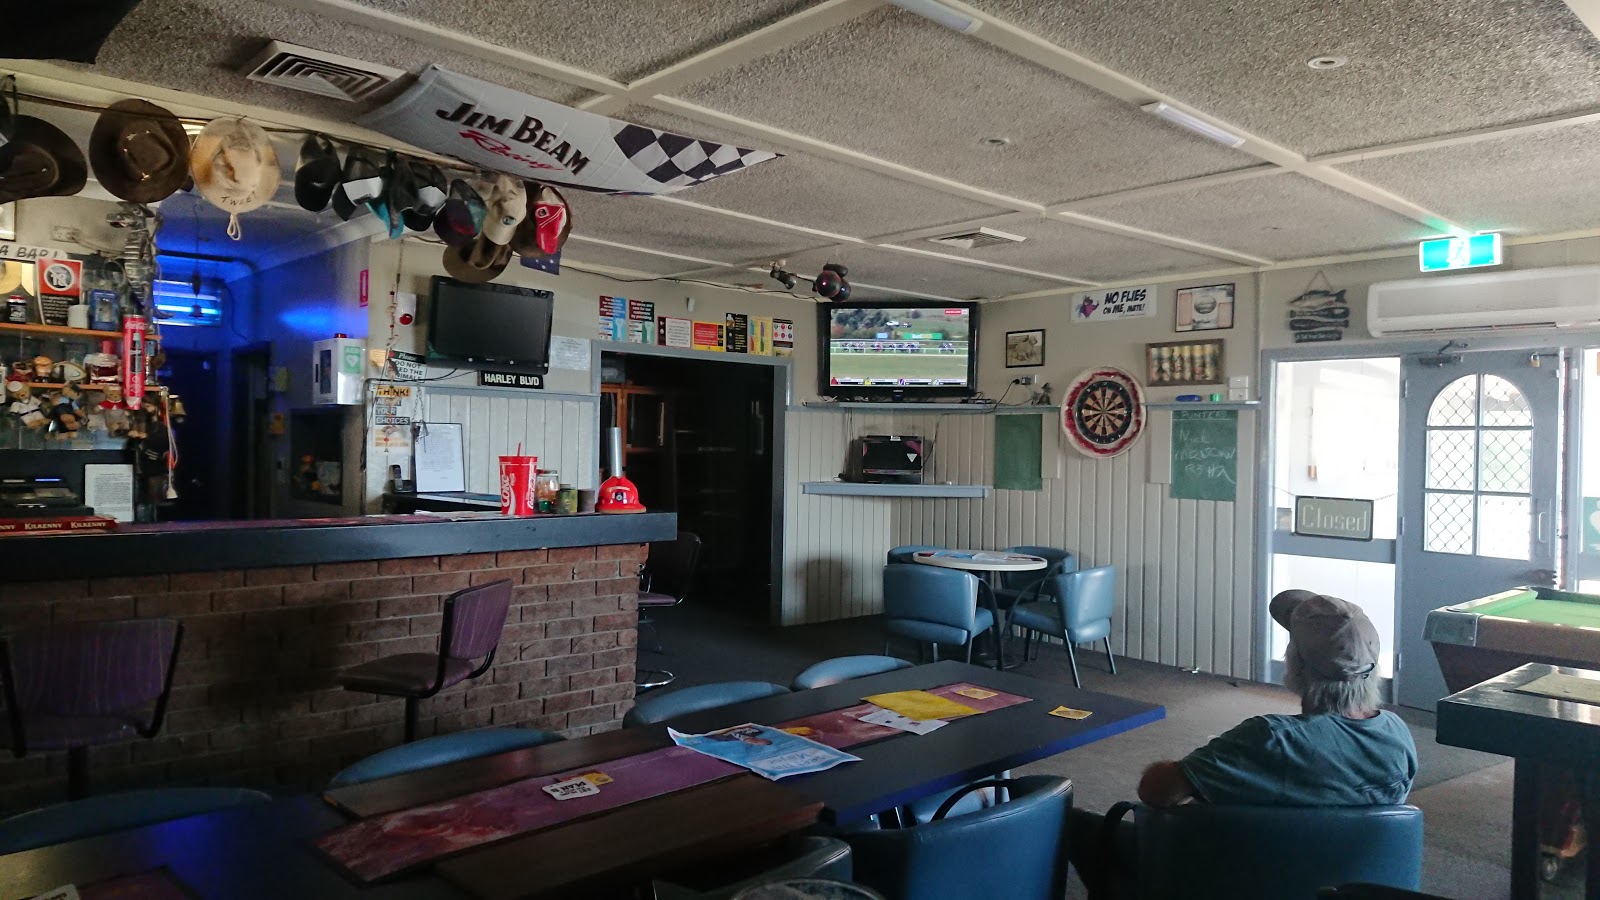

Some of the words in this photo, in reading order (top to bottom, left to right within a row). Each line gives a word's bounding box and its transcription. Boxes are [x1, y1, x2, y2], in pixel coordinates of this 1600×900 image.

[435, 102, 513, 136] JIM
[509, 114, 591, 176] BEAM
[1104, 292, 1119, 305] NO
[1120, 288, 1147, 303] FLIES
[406, 361, 421, 369] NOT
[484, 373, 516, 384] HARLEY
[519, 375, 540, 386] BLVD
[24, 522, 63, 530] KILKENNY
[70, 521, 107, 529] KILKENNY
[1301, 504, 1368, 532] Closed
